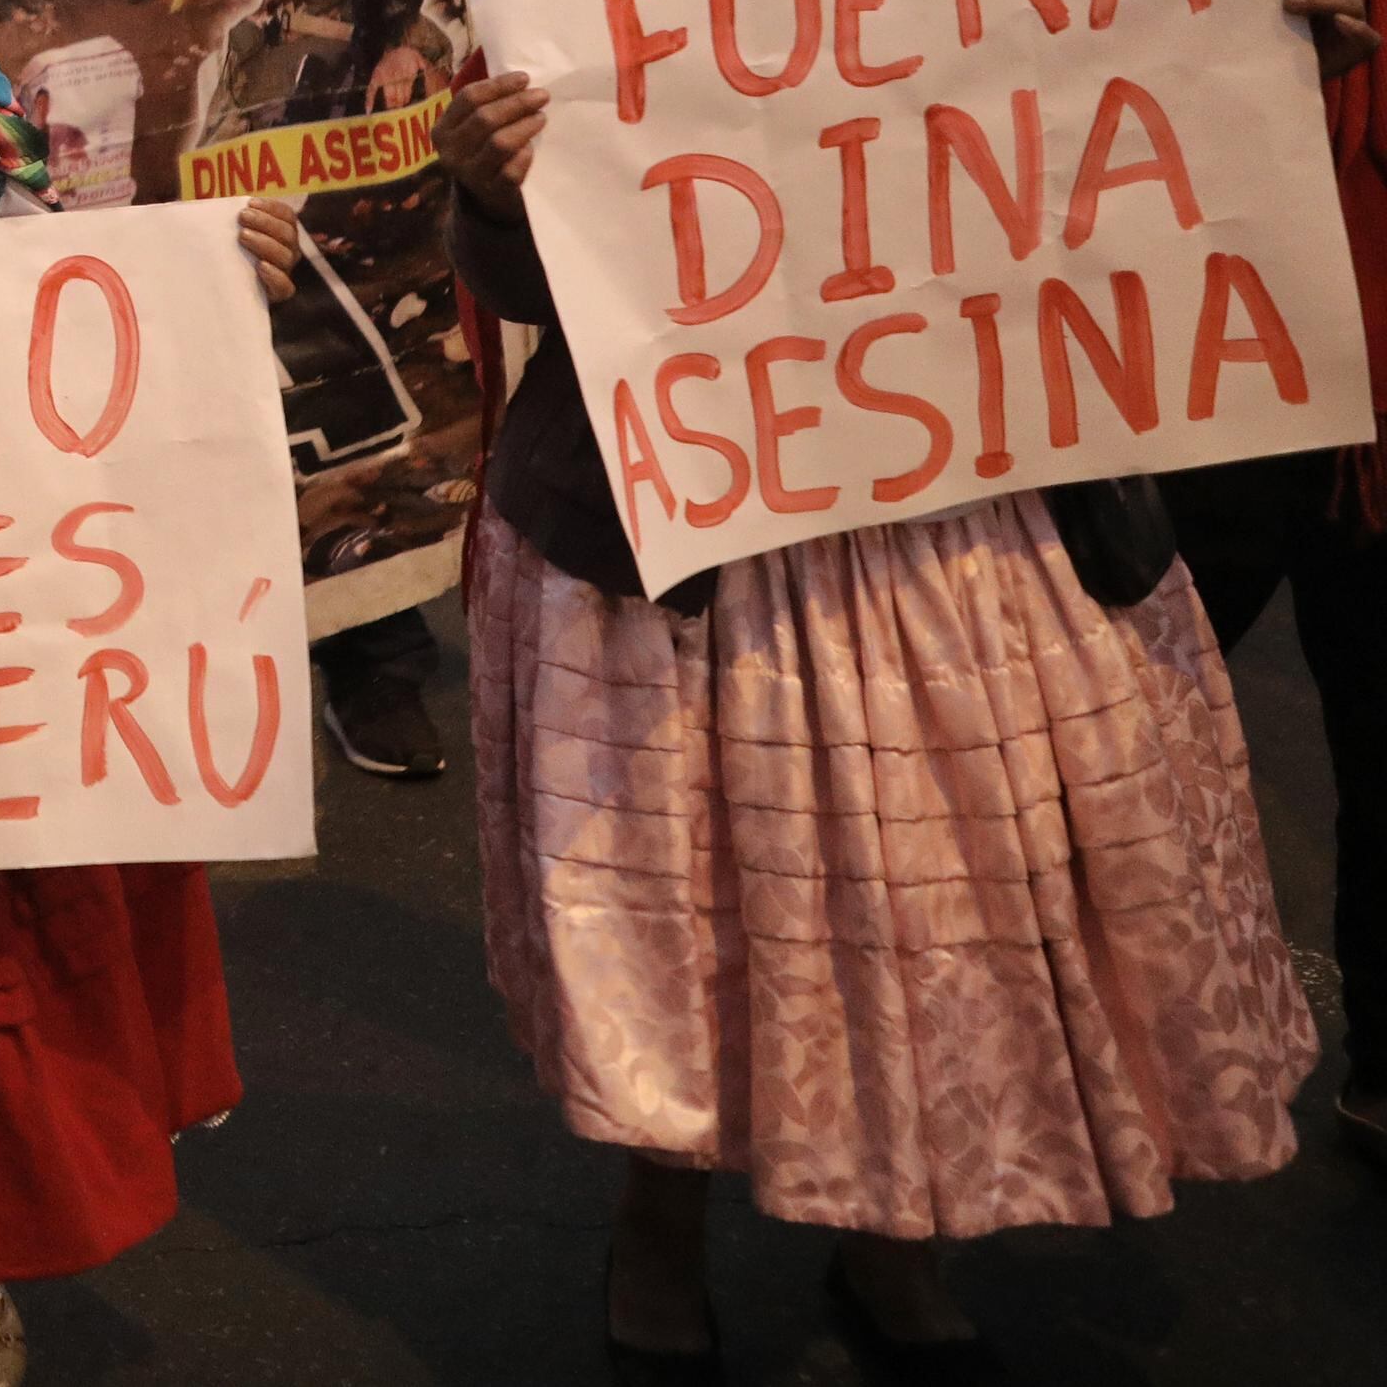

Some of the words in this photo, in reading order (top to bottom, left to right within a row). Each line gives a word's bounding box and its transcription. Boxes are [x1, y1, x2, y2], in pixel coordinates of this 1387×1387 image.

[191, 139, 287, 199] DINA
[640, 77, 1204, 326] DINA
[610, 252, 1309, 554] ASESINA
